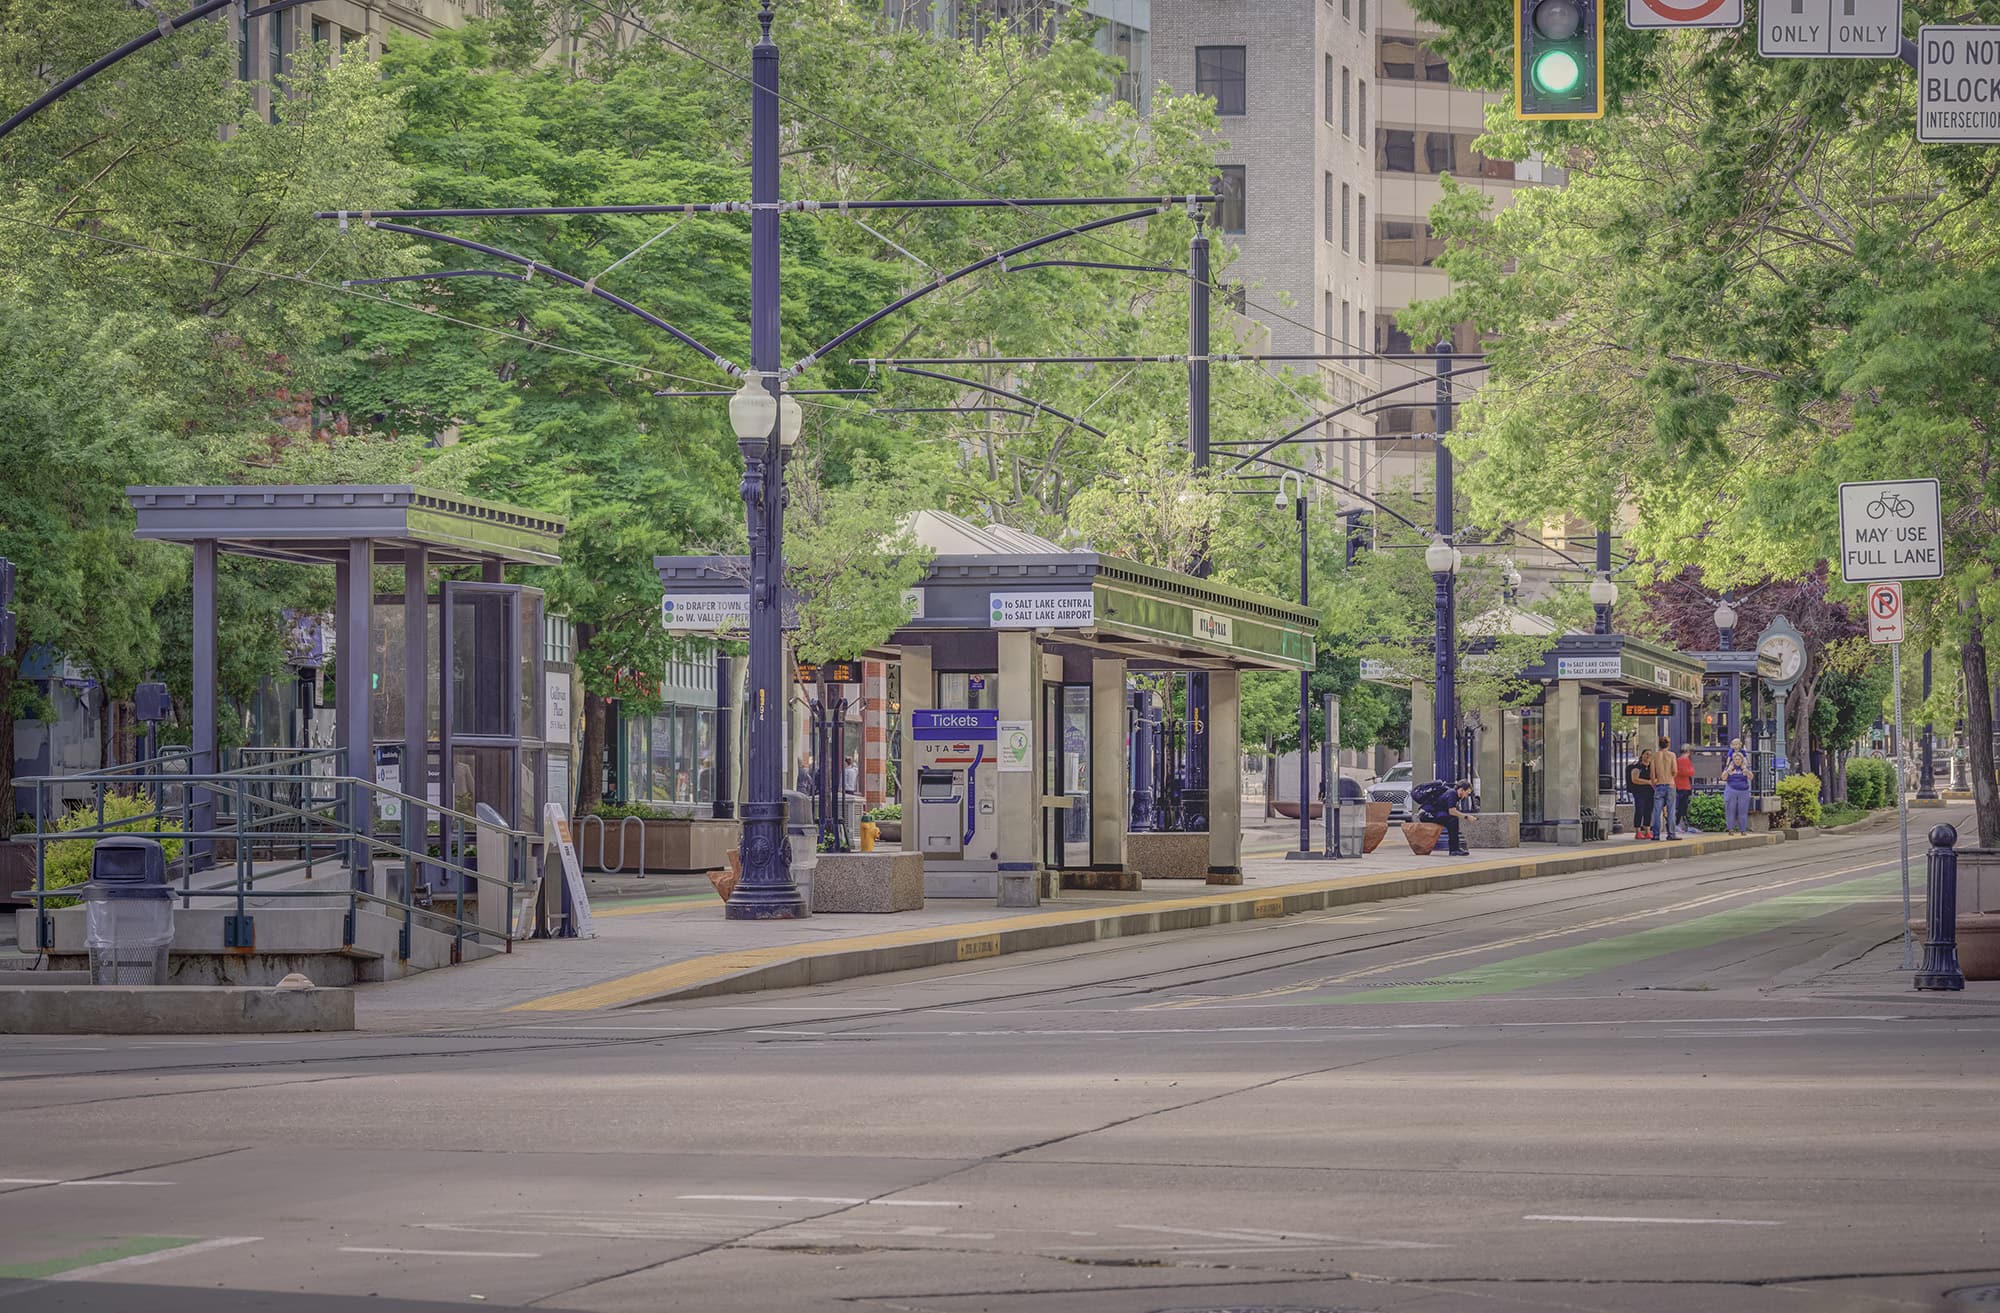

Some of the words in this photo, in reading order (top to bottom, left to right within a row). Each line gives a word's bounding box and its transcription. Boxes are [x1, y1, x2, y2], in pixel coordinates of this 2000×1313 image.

[1771, 25, 1820, 42] ONLY
[1839, 25, 1888, 42] ONLY
[1927, 40, 1955, 65] DO
[1966, 40, 2000, 65] NOT
[1927, 78, 2000, 103] BLOCK
[1855, 527, 1889, 543] MAY
[1896, 526, 1928, 542] USE
[1848, 550, 1887, 565] FULL
[1894, 548, 1936, 564] LANE
[686, 601, 716, 610] DRAPER
[1015, 599, 1033, 608] SALT
[1035, 599, 1055, 608] LAKE
[1057, 598, 1092, 608] CENTRAL
[697, 613, 723, 622] VALLEY
[1005, 612, 1013, 620] to
[1015, 611, 1033, 620] SALT
[1035, 611, 1055, 620] LAKE
[1057, 610, 1091, 620] AIRPORT
[930, 714, 978, 727] Tickets
